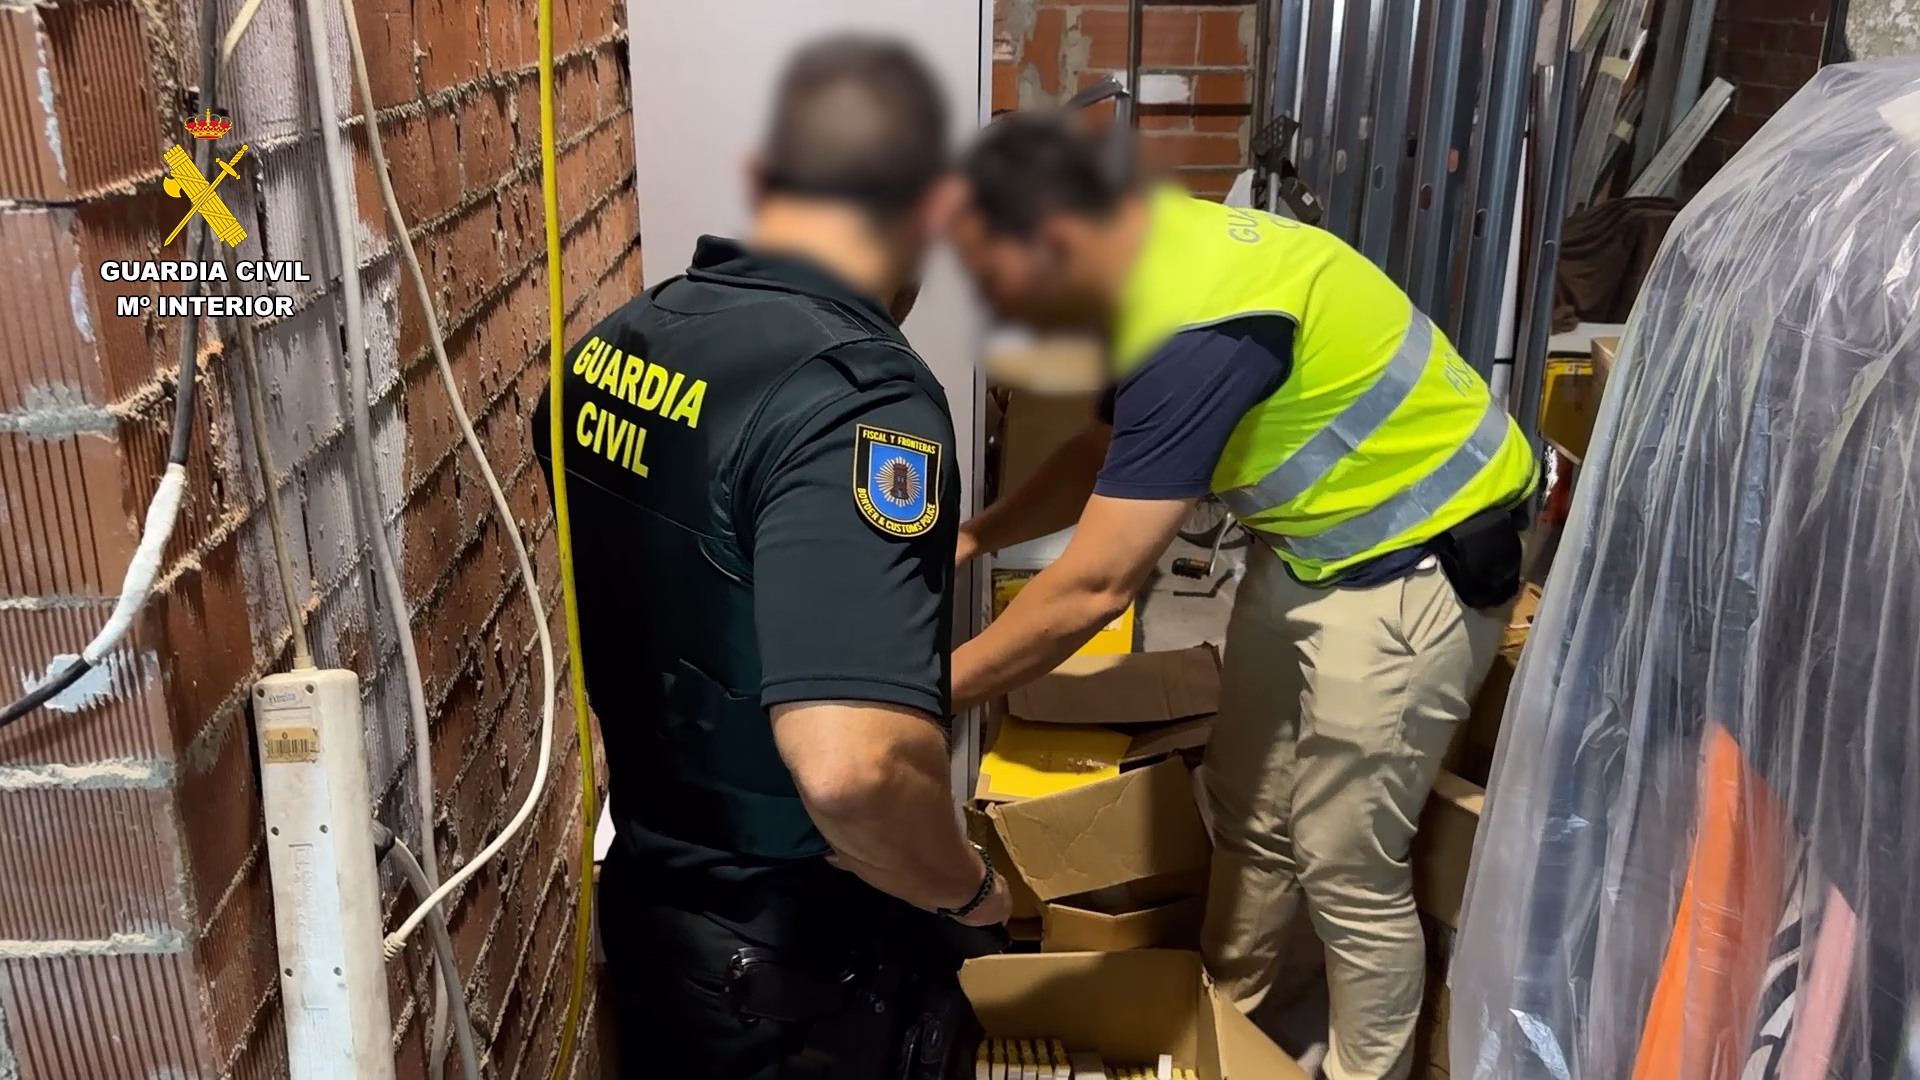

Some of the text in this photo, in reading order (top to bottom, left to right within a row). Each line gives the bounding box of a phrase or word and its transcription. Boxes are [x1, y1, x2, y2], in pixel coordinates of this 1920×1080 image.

[572, 335, 708, 429] GUARDIA
[576, 401, 649, 479] CIVIL
[862, 429, 936, 454] FISCAL Y FRONTERAS
[857, 487, 936, 533] BORDER & CUSTOMS POLICE
